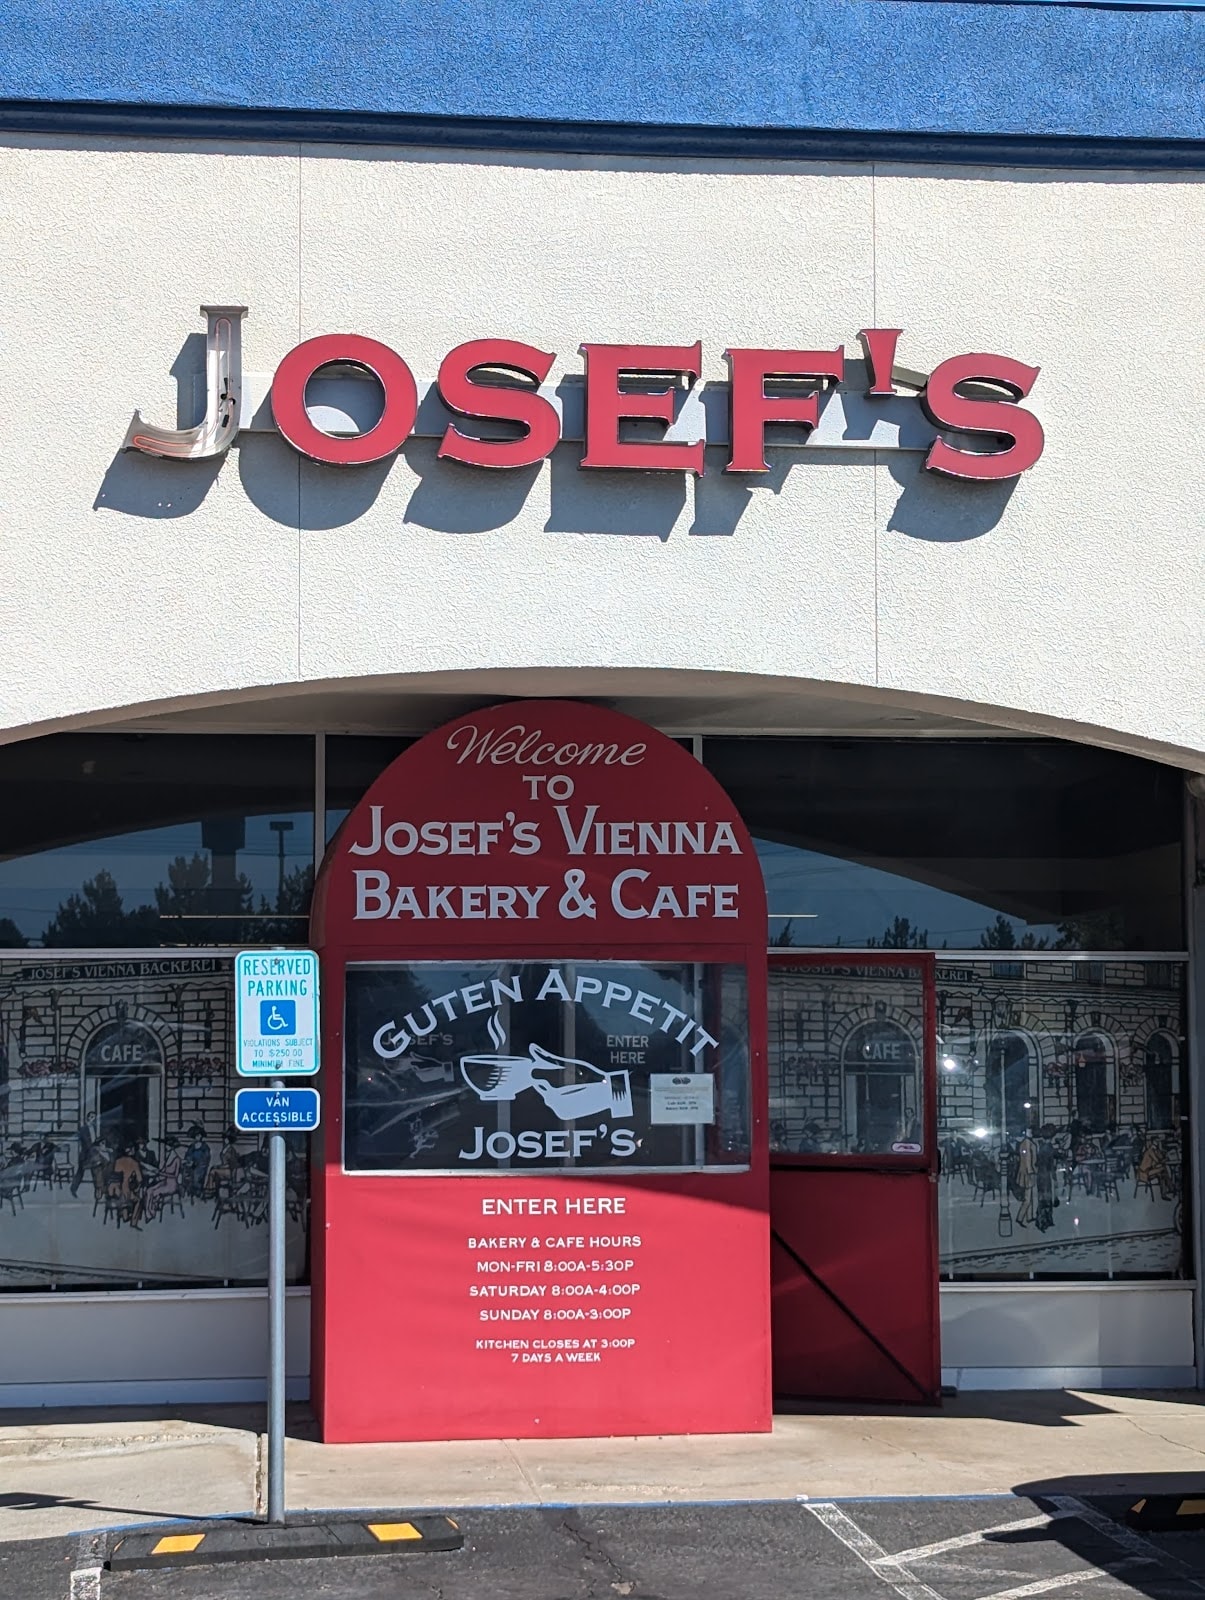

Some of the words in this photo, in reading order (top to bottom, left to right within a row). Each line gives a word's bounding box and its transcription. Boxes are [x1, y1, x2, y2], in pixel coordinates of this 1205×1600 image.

[122, 305, 1044, 479] JOSEF'S
[446, 725, 647, 767] Welcome
[522, 775, 575, 800] TO
[348, 805, 541, 856] JOSEF'S
[552, 805, 743, 856] VIENNA
[351, 869, 550, 921] BAKERY
[558, 868, 597, 921] &
[611, 868, 739, 919] CAFE
[84, 963, 136, 977] VIENNA
[140, 959, 216, 975] BACKEREI
[243, 958, 311, 976] RESERVED
[790, 966, 851, 976] JOSEFS
[248, 979, 307, 997] PARKING
[372, 974, 523, 1058] GUTEN
[535, 968, 719, 1058] APPETIT
[243, 1038, 281, 1047] VIOLATIONS
[285, 1037, 313, 1047] SUBJECT
[382, 1032, 454, 1046] JSEF'S
[606, 1035, 649, 1048] ENTER
[101, 1044, 142, 1062] CAFE
[254, 1049, 264, 1058] TO
[610, 1051, 646, 1064] HERE
[862, 1043, 901, 1060] CAFE
[289, 1059, 305, 1068] FINE
[266, 1096, 290, 1107] VAN
[242, 1111, 314, 1123] ACCESSIBLE
[458, 1123, 637, 1160] JOSEF'S
[482, 1198, 558, 1215] ENTER
[566, 1198, 626, 1214] HERE
[468, 1237, 527, 1249] BAKERY
[531, 1237, 541, 1248] &
[545, 1236, 585, 1248] CAFE
[589, 1236, 642, 1248] HOURS
[477, 1261, 541, 1273] MON-FRI
[543, 1260, 634, 1272] 8:00A-5:30P
[469, 1285, 547, 1297] SATURDAY
[551, 1284, 641, 1296] 8:00A-4:00P
[479, 1309, 540, 1321] SUNDAY
[543, 1308, 631, 1320] 8:00A-3:00P
[475, 1339, 529, 1349] KITCHEN
[532, 1339, 580, 1349] CLOSES
[582, 1339, 597, 1349] AT
[601, 1338, 636, 1348] 3:00P
[511, 1353, 519, 1363] 7
[522, 1353, 552, 1363] DAYS
[555, 1353, 563, 1363] A
[566, 1352, 601, 1363] WEEK
